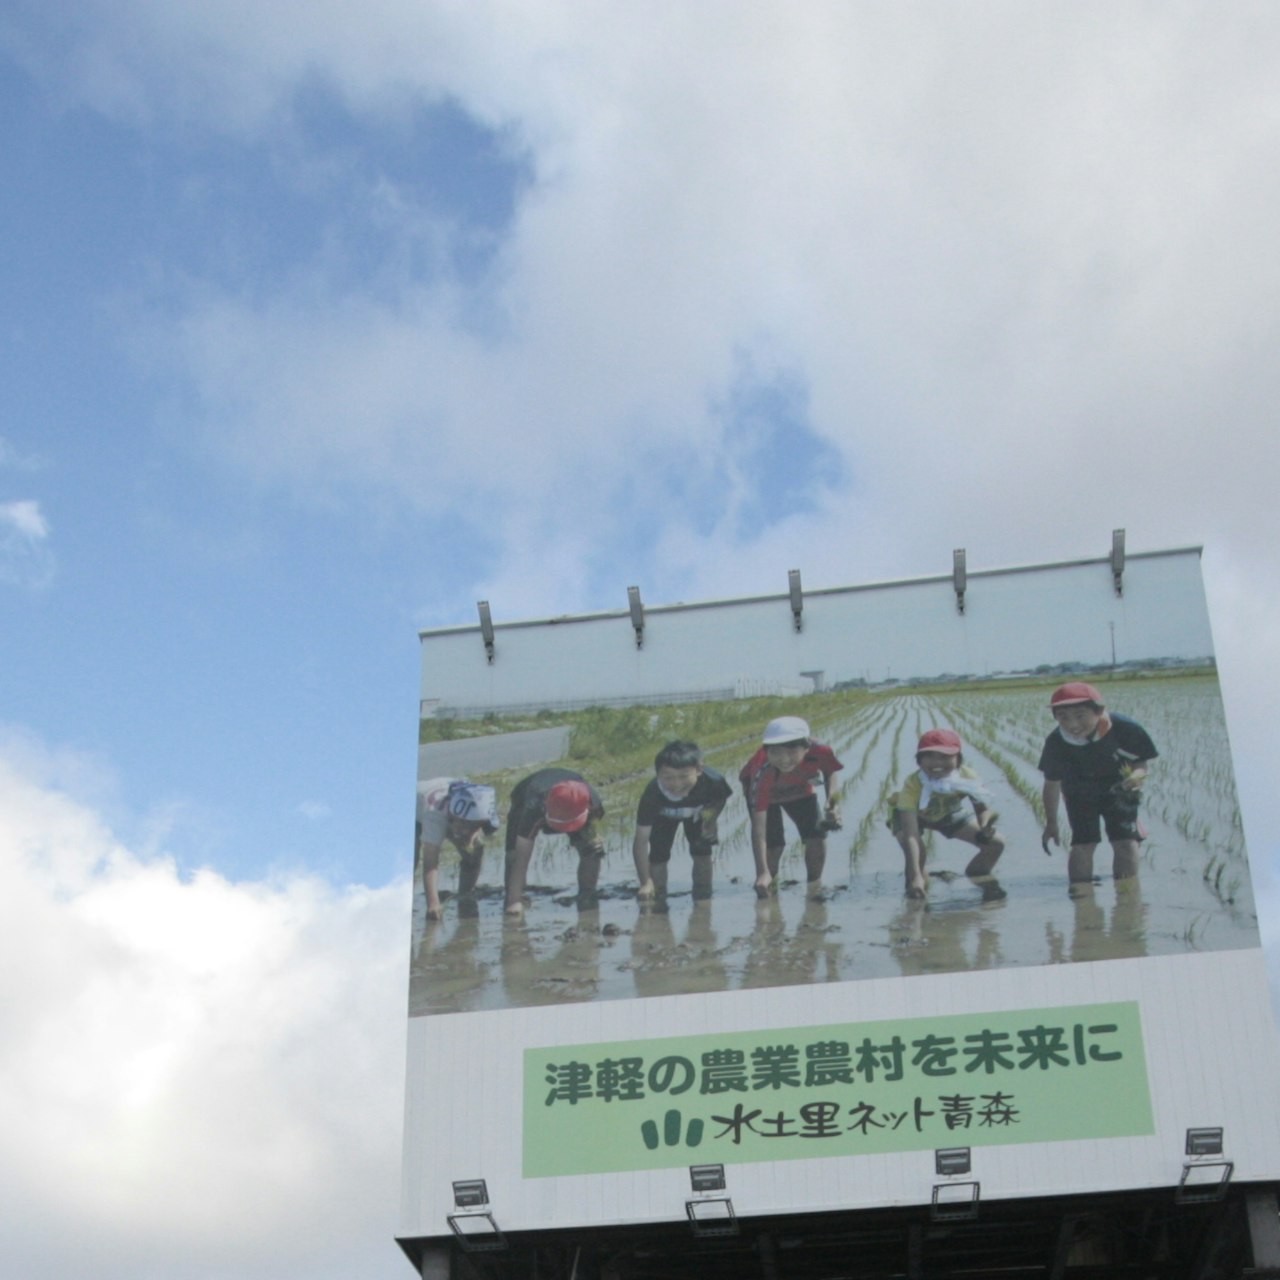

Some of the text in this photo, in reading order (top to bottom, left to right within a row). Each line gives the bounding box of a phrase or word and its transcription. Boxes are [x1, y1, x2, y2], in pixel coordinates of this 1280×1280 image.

[543, 1021, 1124, 1108] 津軽の農業農村を未来に
[710, 1089, 1022, 1146] 水土里ネット青森
